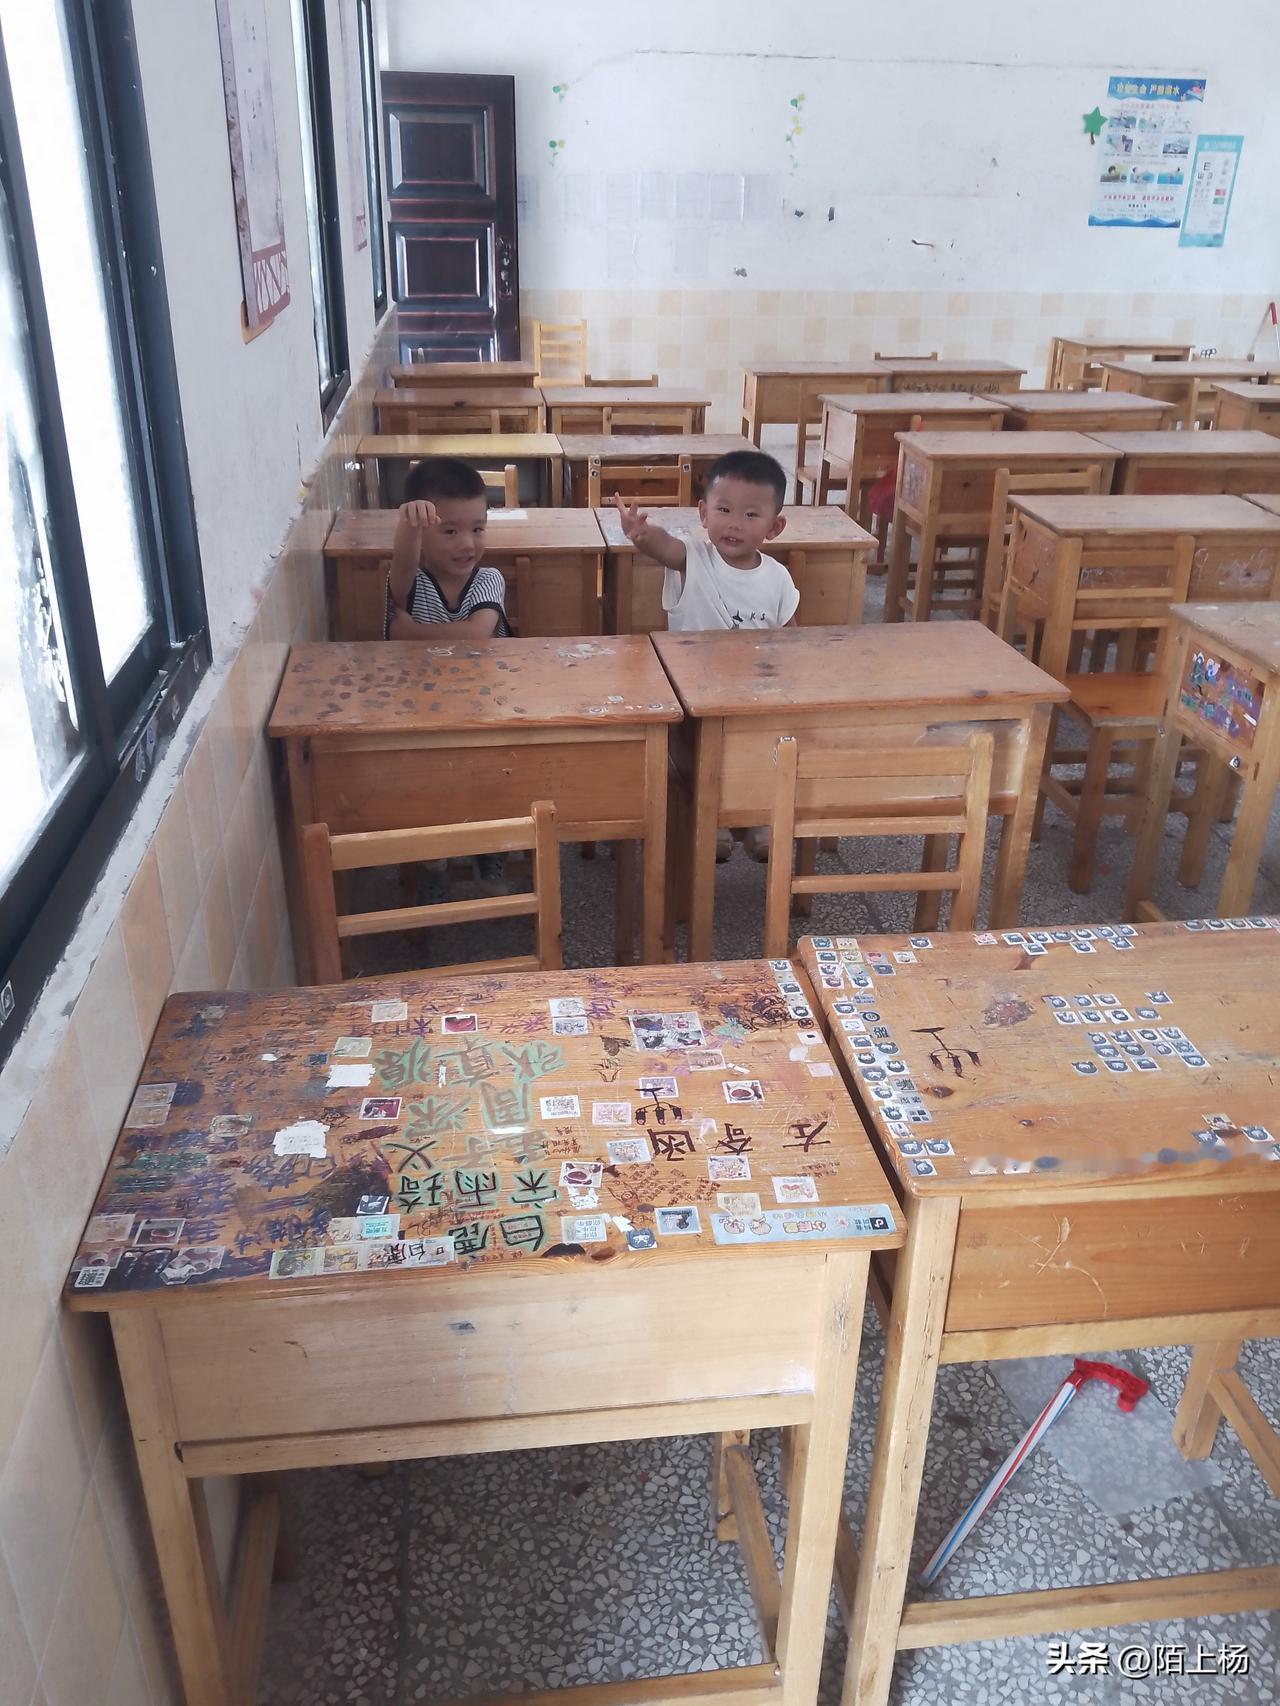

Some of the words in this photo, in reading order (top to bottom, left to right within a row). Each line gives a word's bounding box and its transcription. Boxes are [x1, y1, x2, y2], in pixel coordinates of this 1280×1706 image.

[647, 1121, 831, 1162] 左奇函
[397, 1170, 560, 1213] 宋雨琦
[448, 1214, 545, 1260] 白鹿
